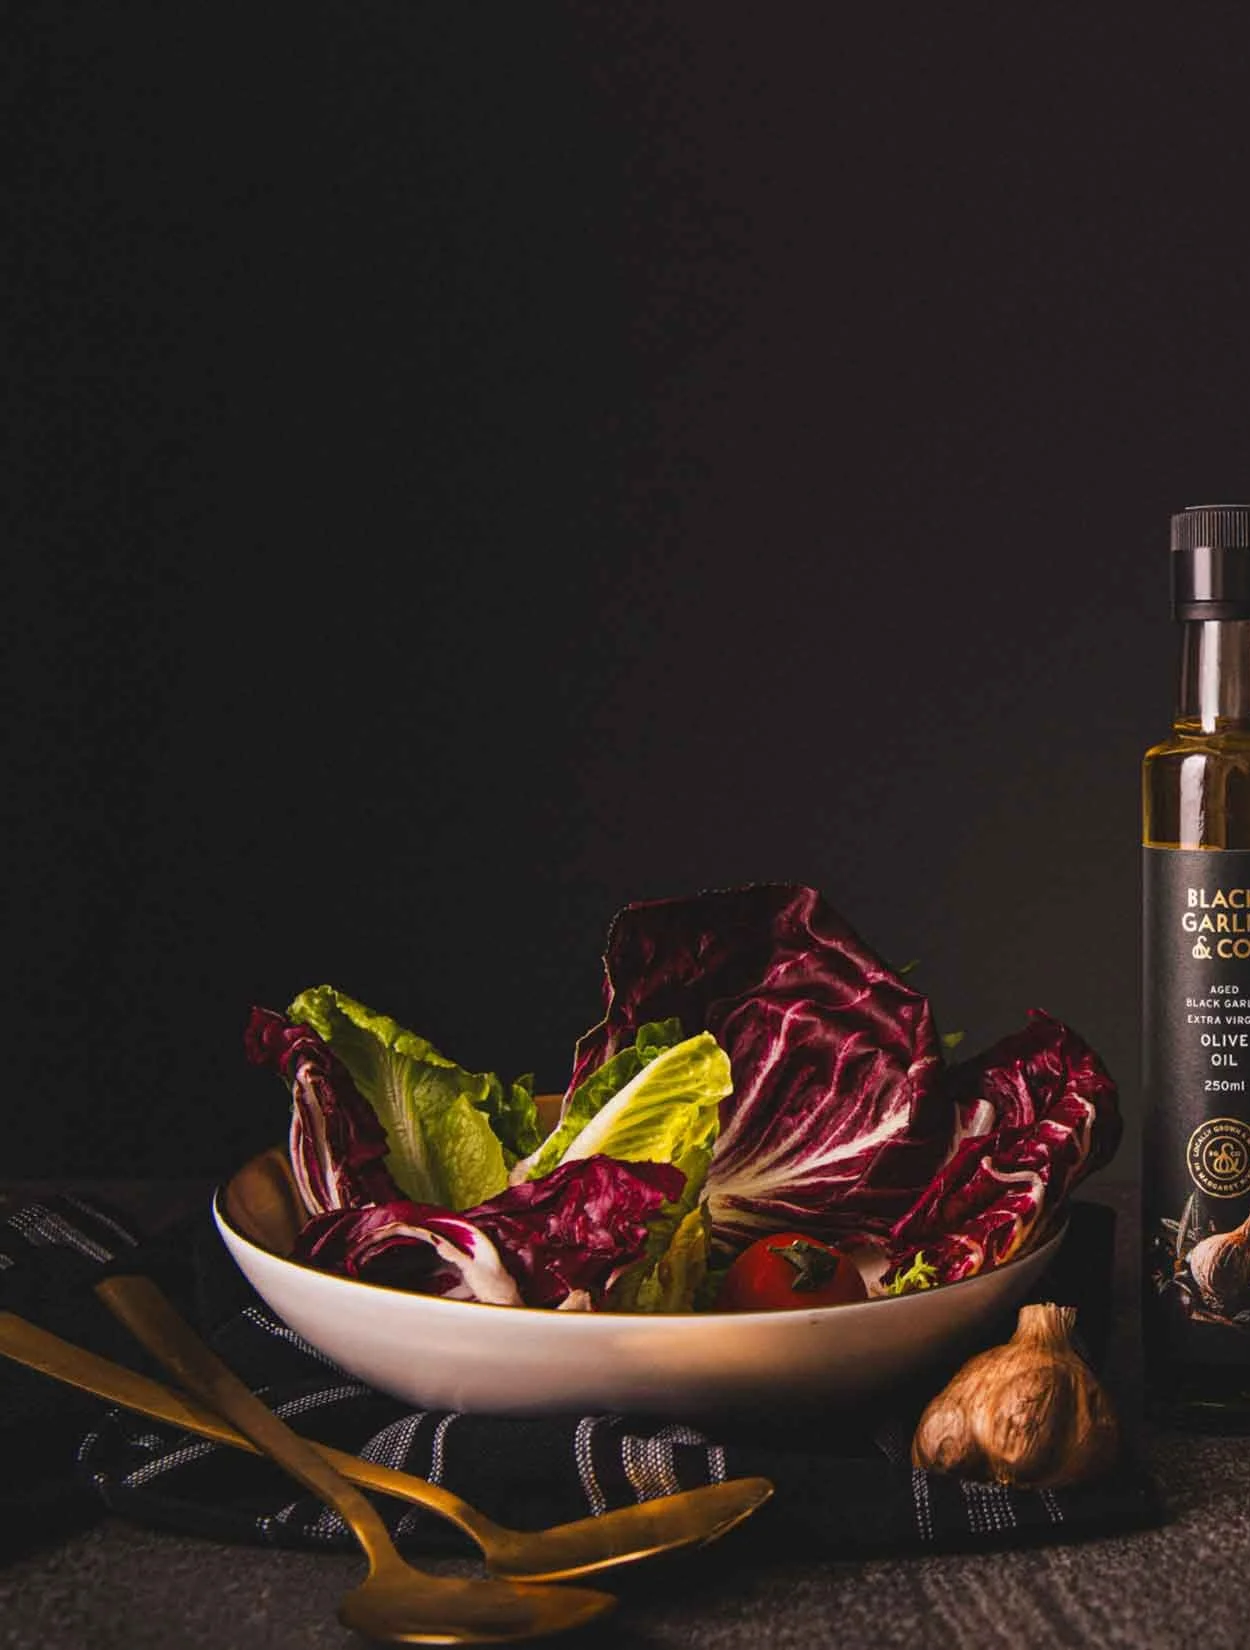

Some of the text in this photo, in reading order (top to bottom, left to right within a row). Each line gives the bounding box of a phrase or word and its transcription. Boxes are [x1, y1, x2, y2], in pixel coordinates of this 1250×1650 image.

[1191, 935, 1213, 959] &
[1209, 985, 1240, 995] AGED
[1186, 998, 1221, 1009] BLACK
[1187, 1015, 1222, 1025] EXTRA
[1200, 1034, 1249, 1047] OLIVE
[1211, 1053, 1239, 1067] OIL
[1204, 1080, 1246, 1092] 250ml
